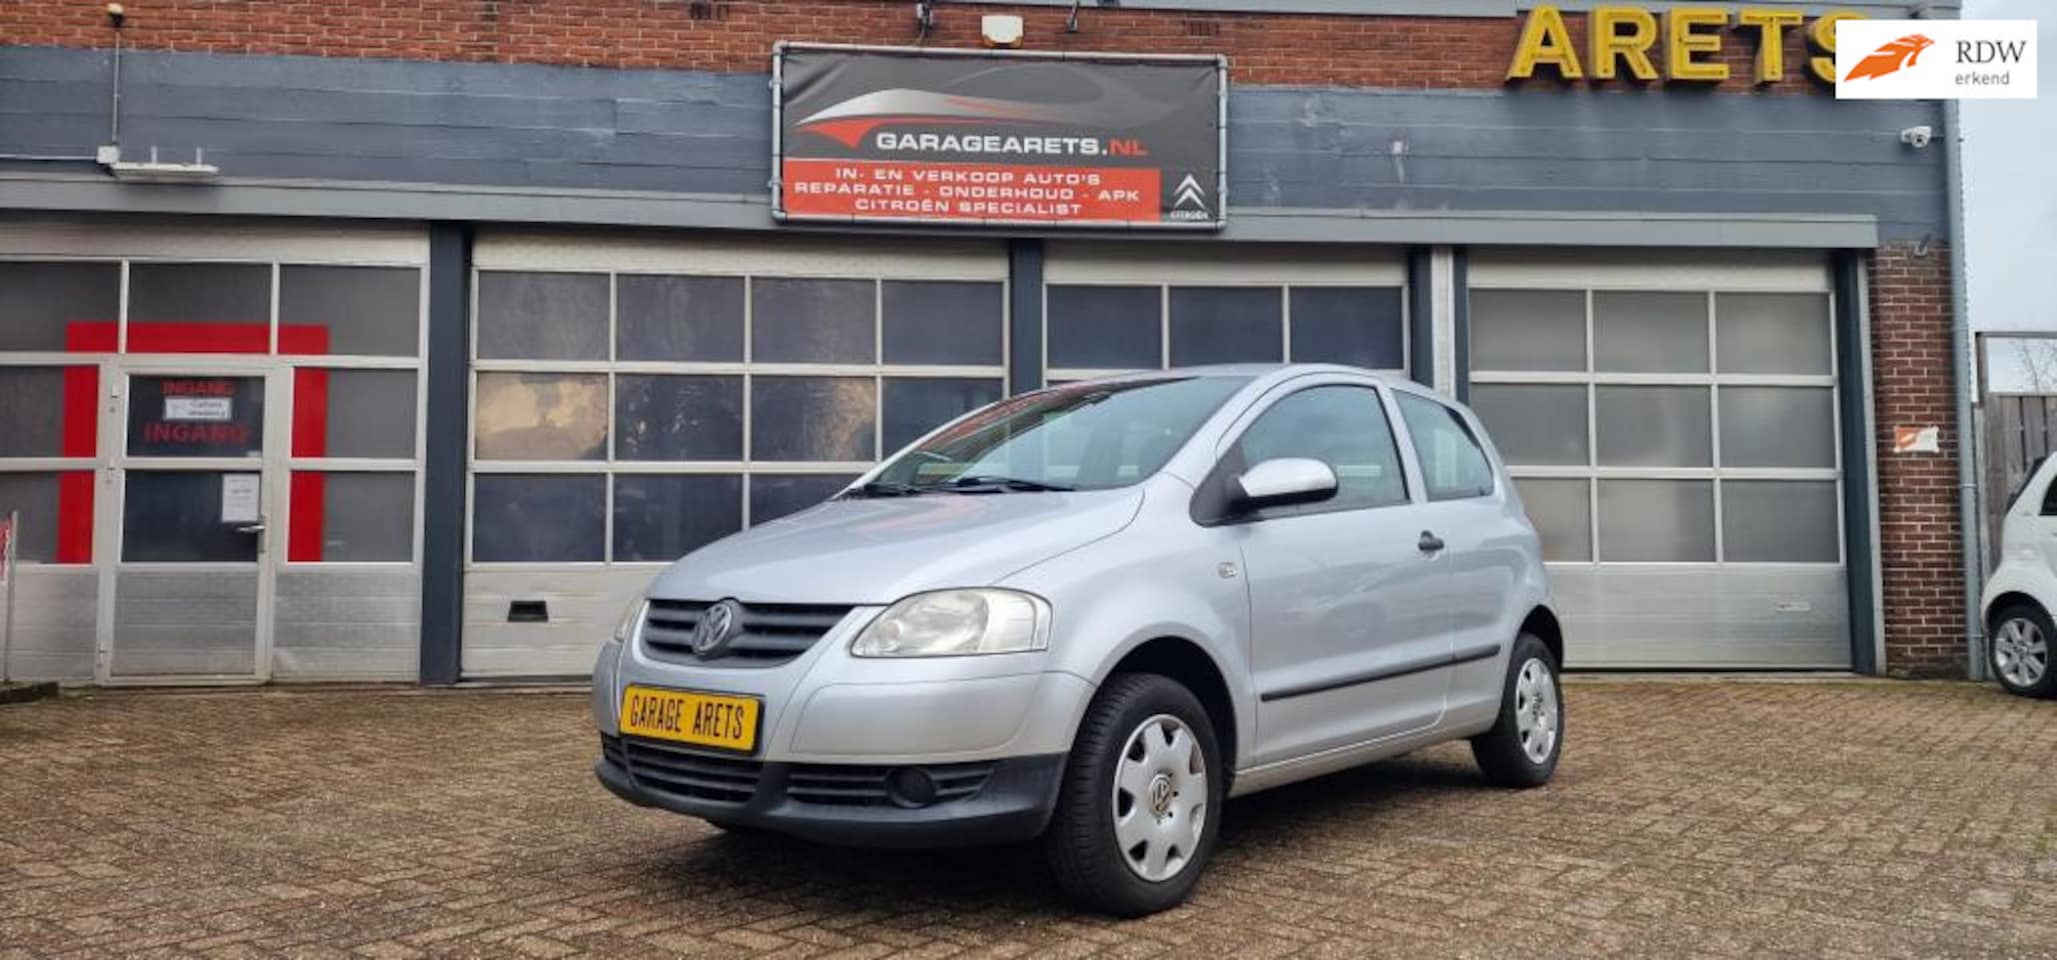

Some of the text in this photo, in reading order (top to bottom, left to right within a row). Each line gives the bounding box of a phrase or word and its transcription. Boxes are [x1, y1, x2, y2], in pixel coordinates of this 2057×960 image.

[877, 133, 1147, 156] GARAGEARETS.NL
[874, 169, 903, 181] EN
[912, 170, 1014, 183] VERKOOP
[1023, 173, 1101, 186] AUTO'S
[794, 182, 914, 196] REPARATIE
[939, 186, 1074, 199] ONDERHOUD
[1098, 190, 1140, 202] APK
[959, 202, 1083, 215] SPECIALIST
[144, 422, 249, 443] INGANG
[630, 695, 744, 740] GARAGE ARETS
